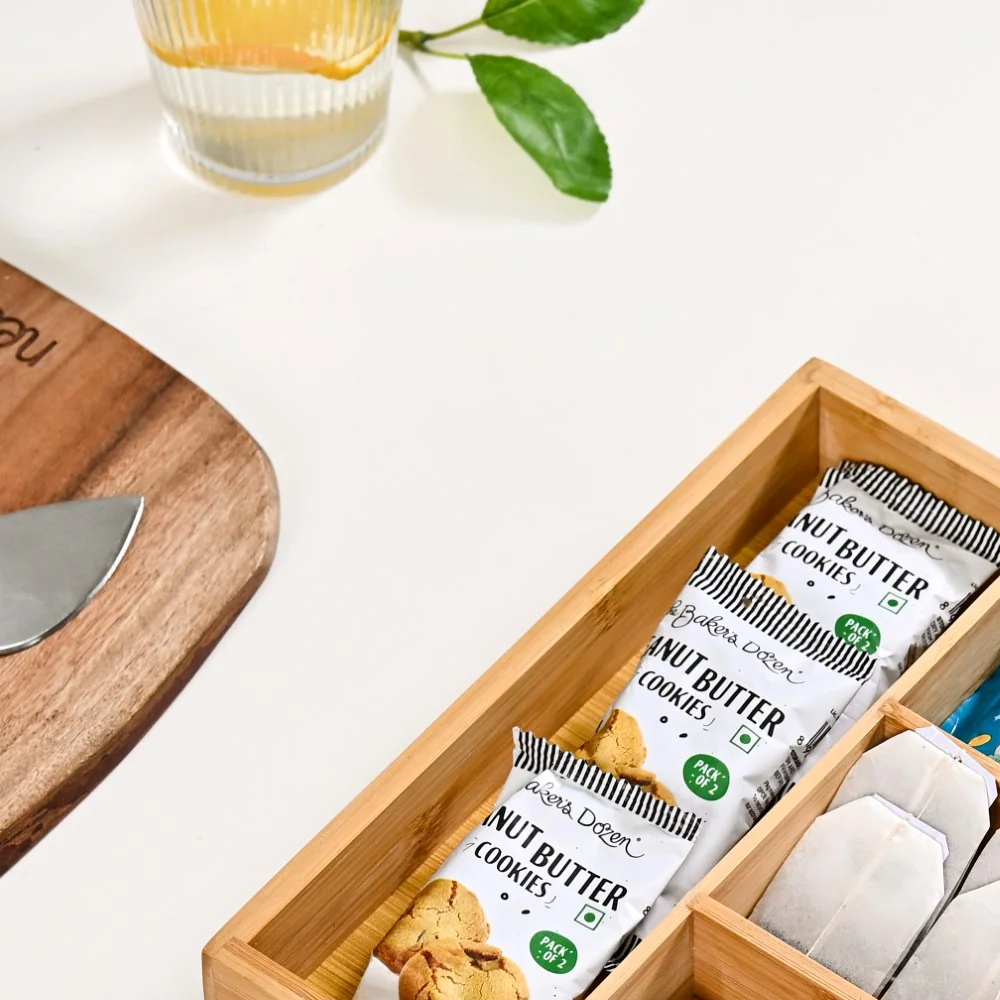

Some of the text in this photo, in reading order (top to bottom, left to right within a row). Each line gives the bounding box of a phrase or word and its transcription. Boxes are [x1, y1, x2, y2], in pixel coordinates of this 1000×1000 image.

[781, 540, 856, 585] COOKIES
[835, 538, 929, 600] BUTTER
[844, 618, 872, 639] PACK
[847, 632, 871, 652] OF 2
[742, 641, 805, 684] Dozen
[638, 670, 712, 720] COOKIES
[644, 636, 786, 737] ANUT BUTTER
[693, 759, 721, 782] PACK
[695, 774, 719, 796] OF 2
[525, 780, 645, 859] aker's Dozen
[474, 841, 552, 898] COOKIES
[529, 842, 628, 912] BUTTER
[540, 935, 569, 957] PACK
[542, 950, 567, 969] OF 2
